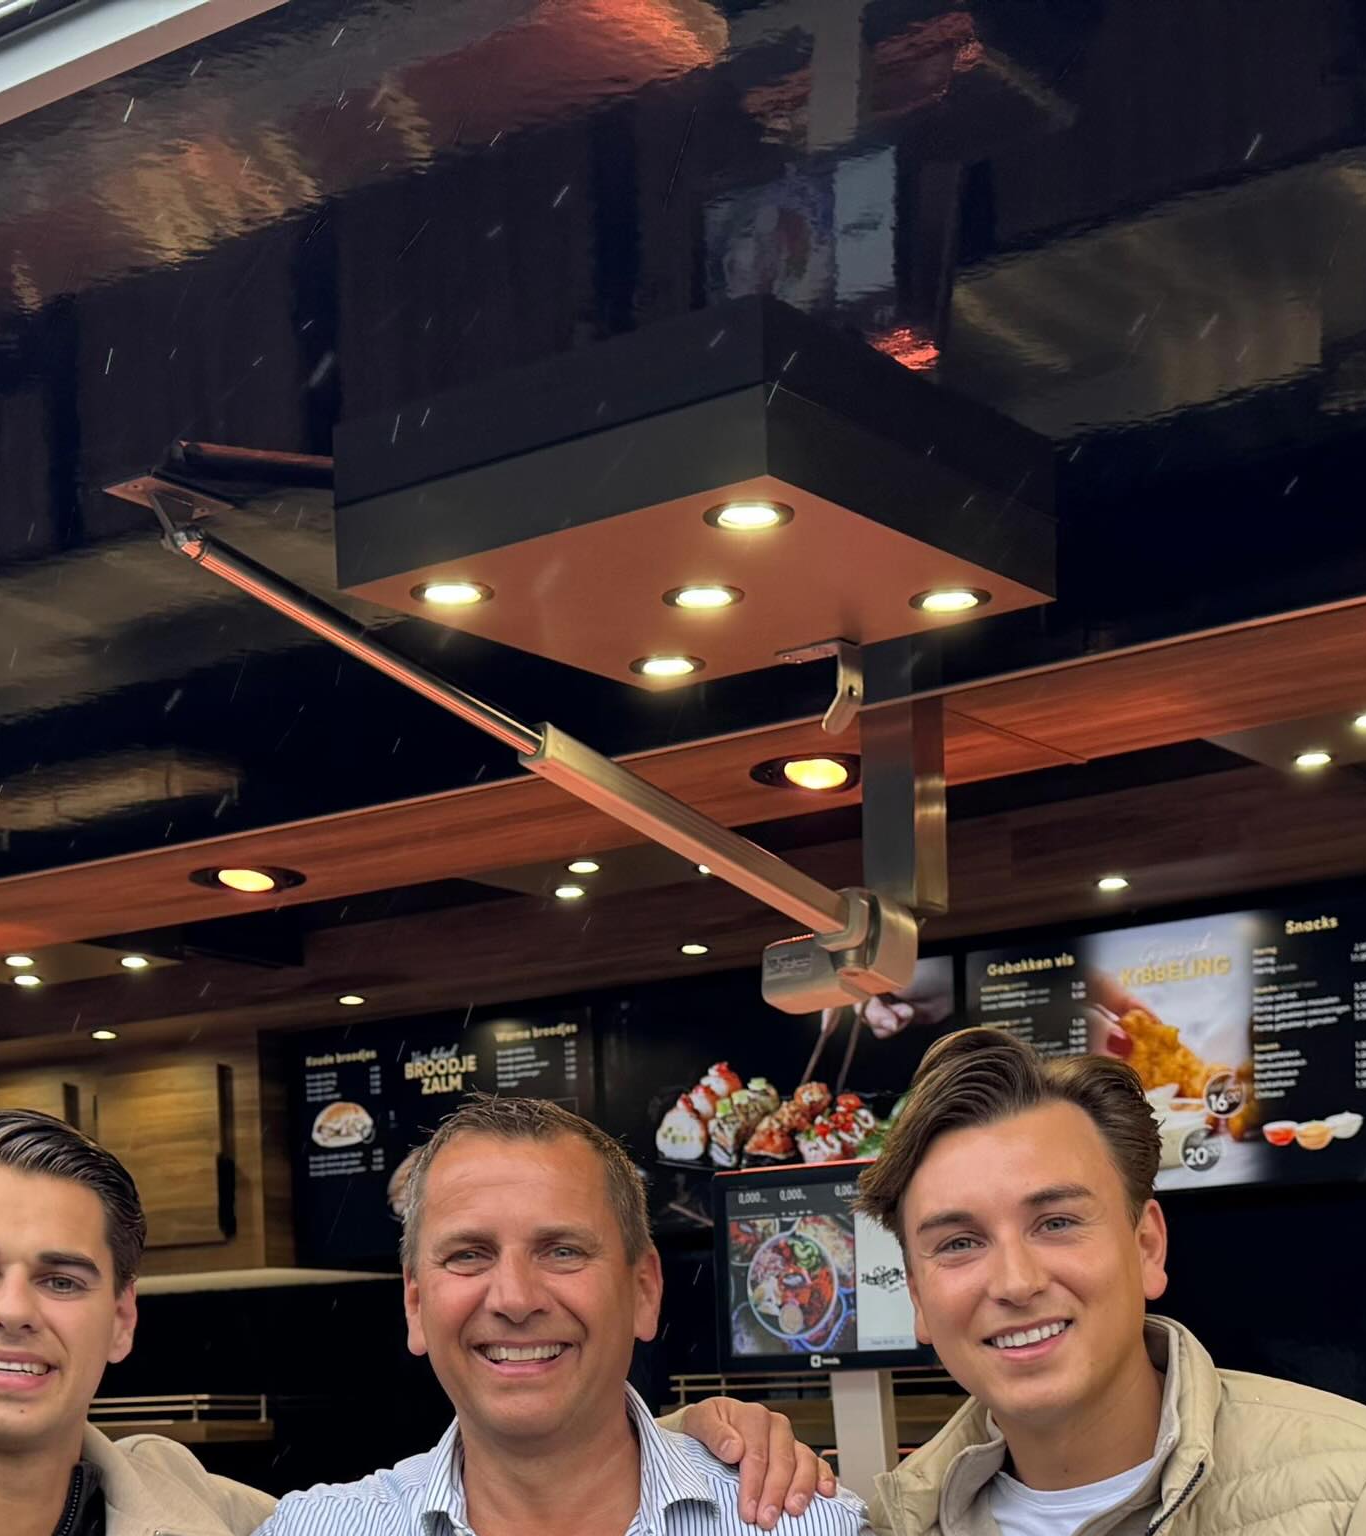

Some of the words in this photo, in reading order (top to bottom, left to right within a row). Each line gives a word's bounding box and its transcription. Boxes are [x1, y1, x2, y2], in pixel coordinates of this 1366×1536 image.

[1285, 915, 1339, 935] Snacks
[987, 957, 1053, 976] Gebakken
[1119, 954, 1232, 988] KIBBELING
[404, 1054, 478, 1080] BROODJE
[421, 1073, 463, 1096] ZALM
